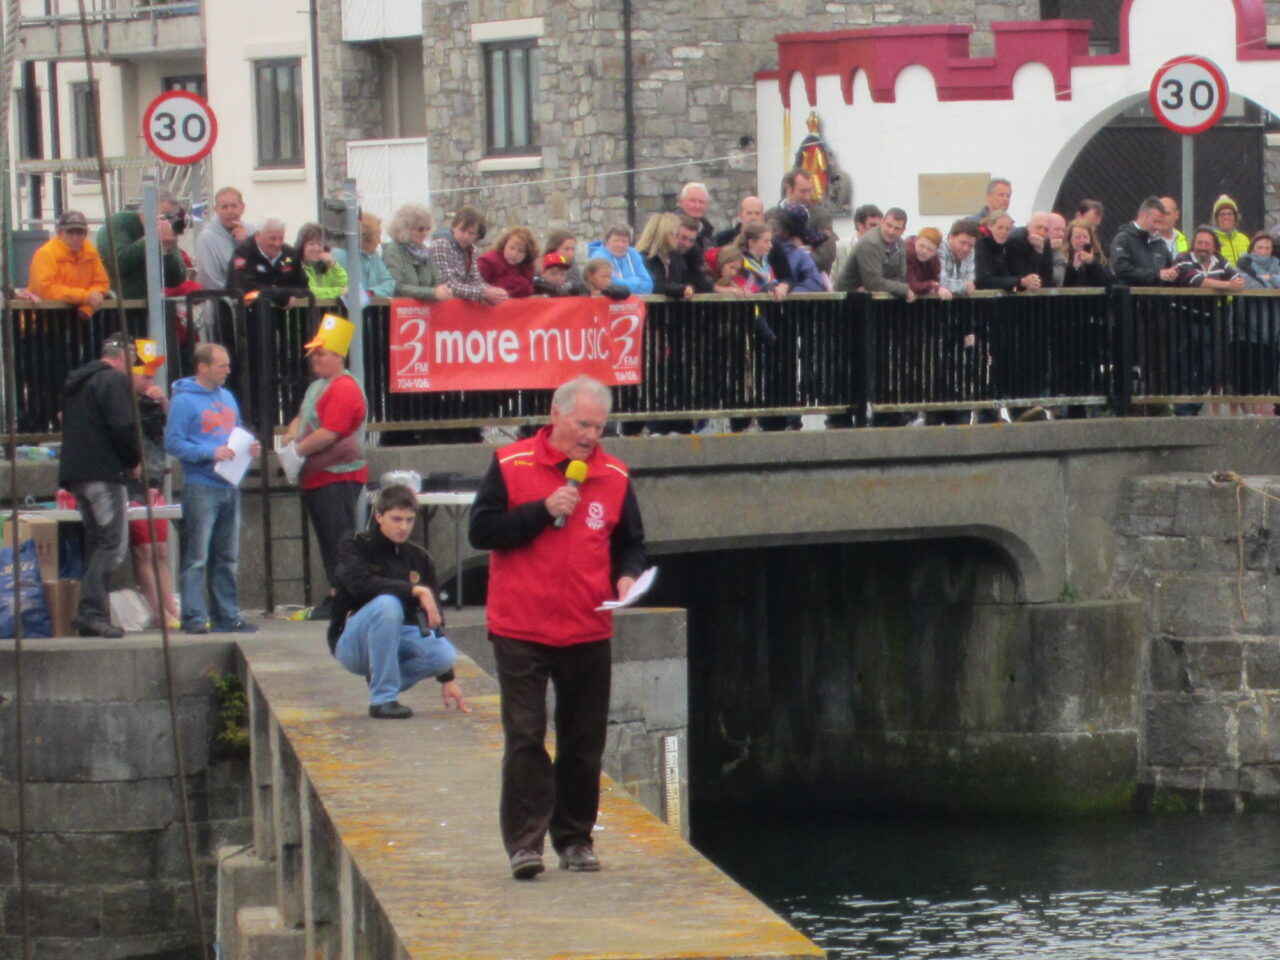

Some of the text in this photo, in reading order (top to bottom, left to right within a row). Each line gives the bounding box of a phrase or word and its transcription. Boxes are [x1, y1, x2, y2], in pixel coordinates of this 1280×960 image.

[1161, 79, 1214, 111] 30
[154, 112, 206, 142] 30
[396, 318, 426, 376] 3
[434, 316, 609, 364] more music
[611, 315, 639, 369] 3
[414, 361, 429, 374] FM
